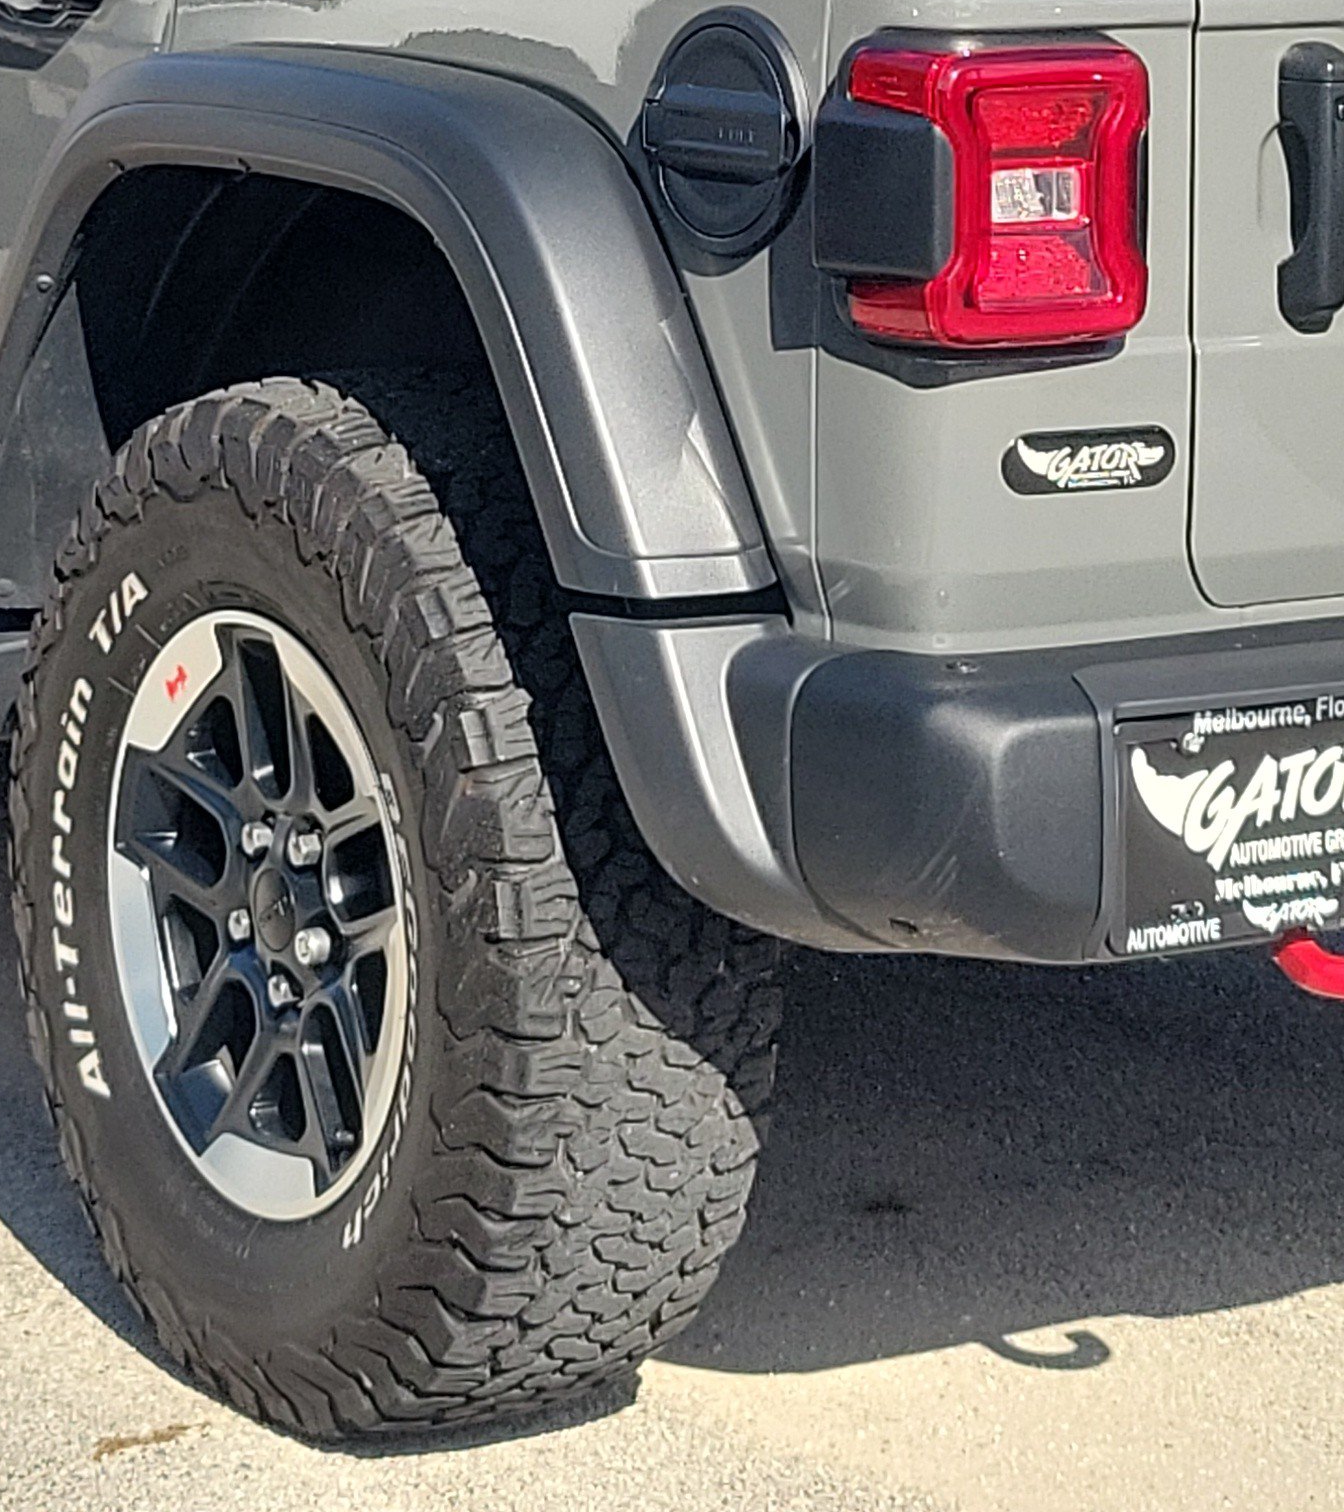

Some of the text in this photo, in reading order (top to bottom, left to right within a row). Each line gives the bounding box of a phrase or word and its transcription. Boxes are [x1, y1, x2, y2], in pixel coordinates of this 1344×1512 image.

[1047, 443, 1142, 488] GATOR
[1193, 702, 1312, 737] Melbourne,
[52, 571, 150, 1100] All-Terrain T/A
[1229, 830, 1324, 868] AUTOMOTIVE
[1126, 917, 1223, 954] AUTOMOTIVE
